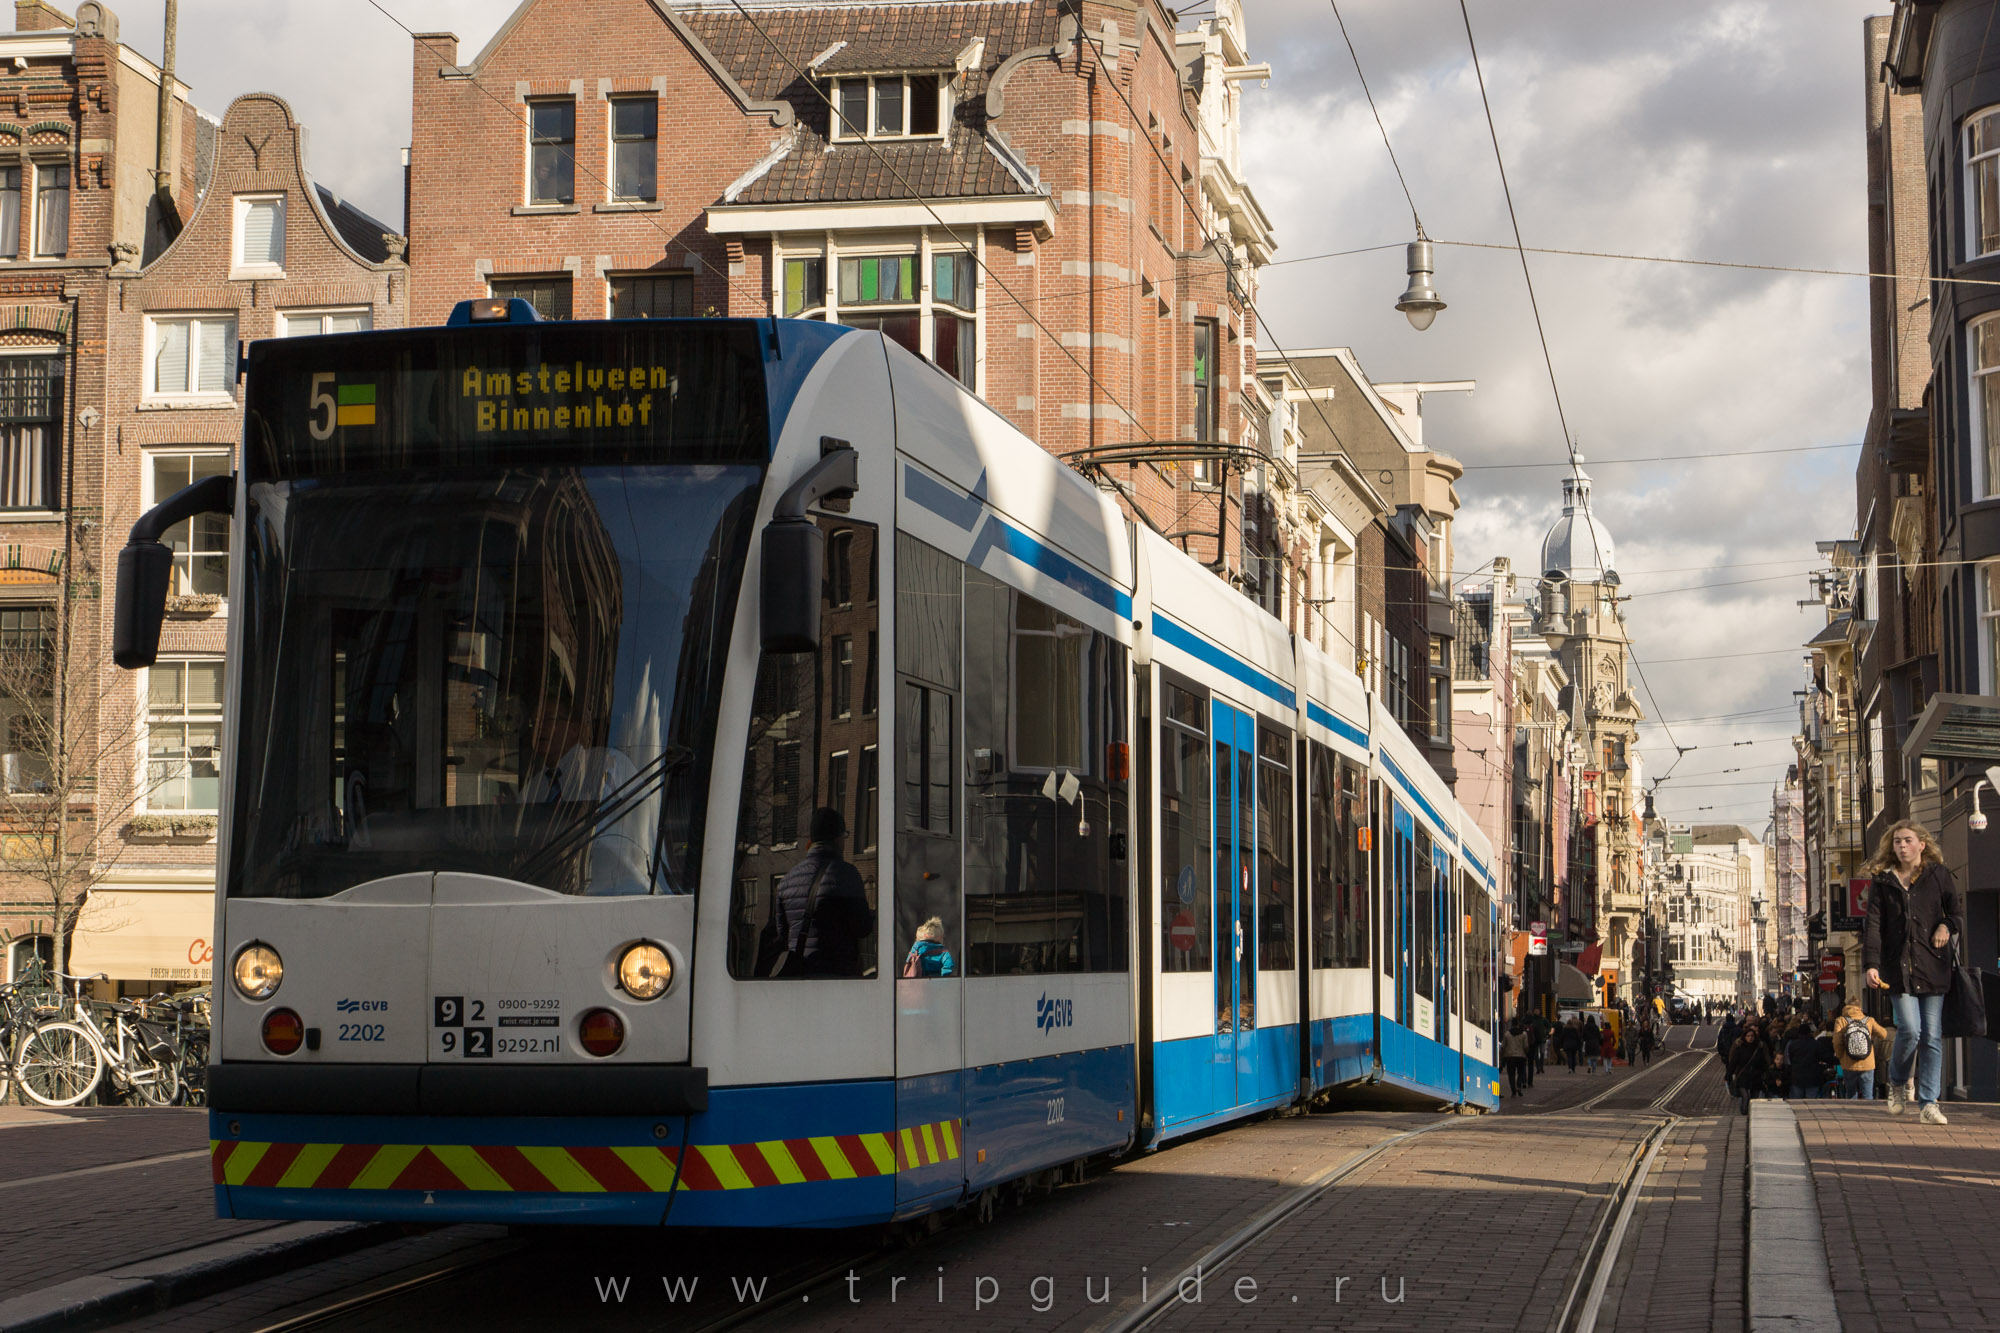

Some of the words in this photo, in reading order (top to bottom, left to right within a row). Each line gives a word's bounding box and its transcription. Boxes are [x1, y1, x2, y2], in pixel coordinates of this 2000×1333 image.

[463, 361, 667, 397] Amstelveen
[308, 372, 337, 441] 5
[477, 394, 652, 432] Binnenhof
[150, 967, 169, 979] FRESH
[170, 967, 191, 979] JUICES
[193, 968, 199, 979] &
[361, 1001, 388, 1011] GVB
[498, 999, 560, 1009] 0900-9292
[1055, 999, 1072, 1027] GVB
[502, 1017, 517, 1025] reist
[518, 1017, 532, 1025] met
[338, 1023, 385, 1042] 2202
[498, 1036, 560, 1053] 9292.nl
[1047, 1097, 1065, 1125] 2202
